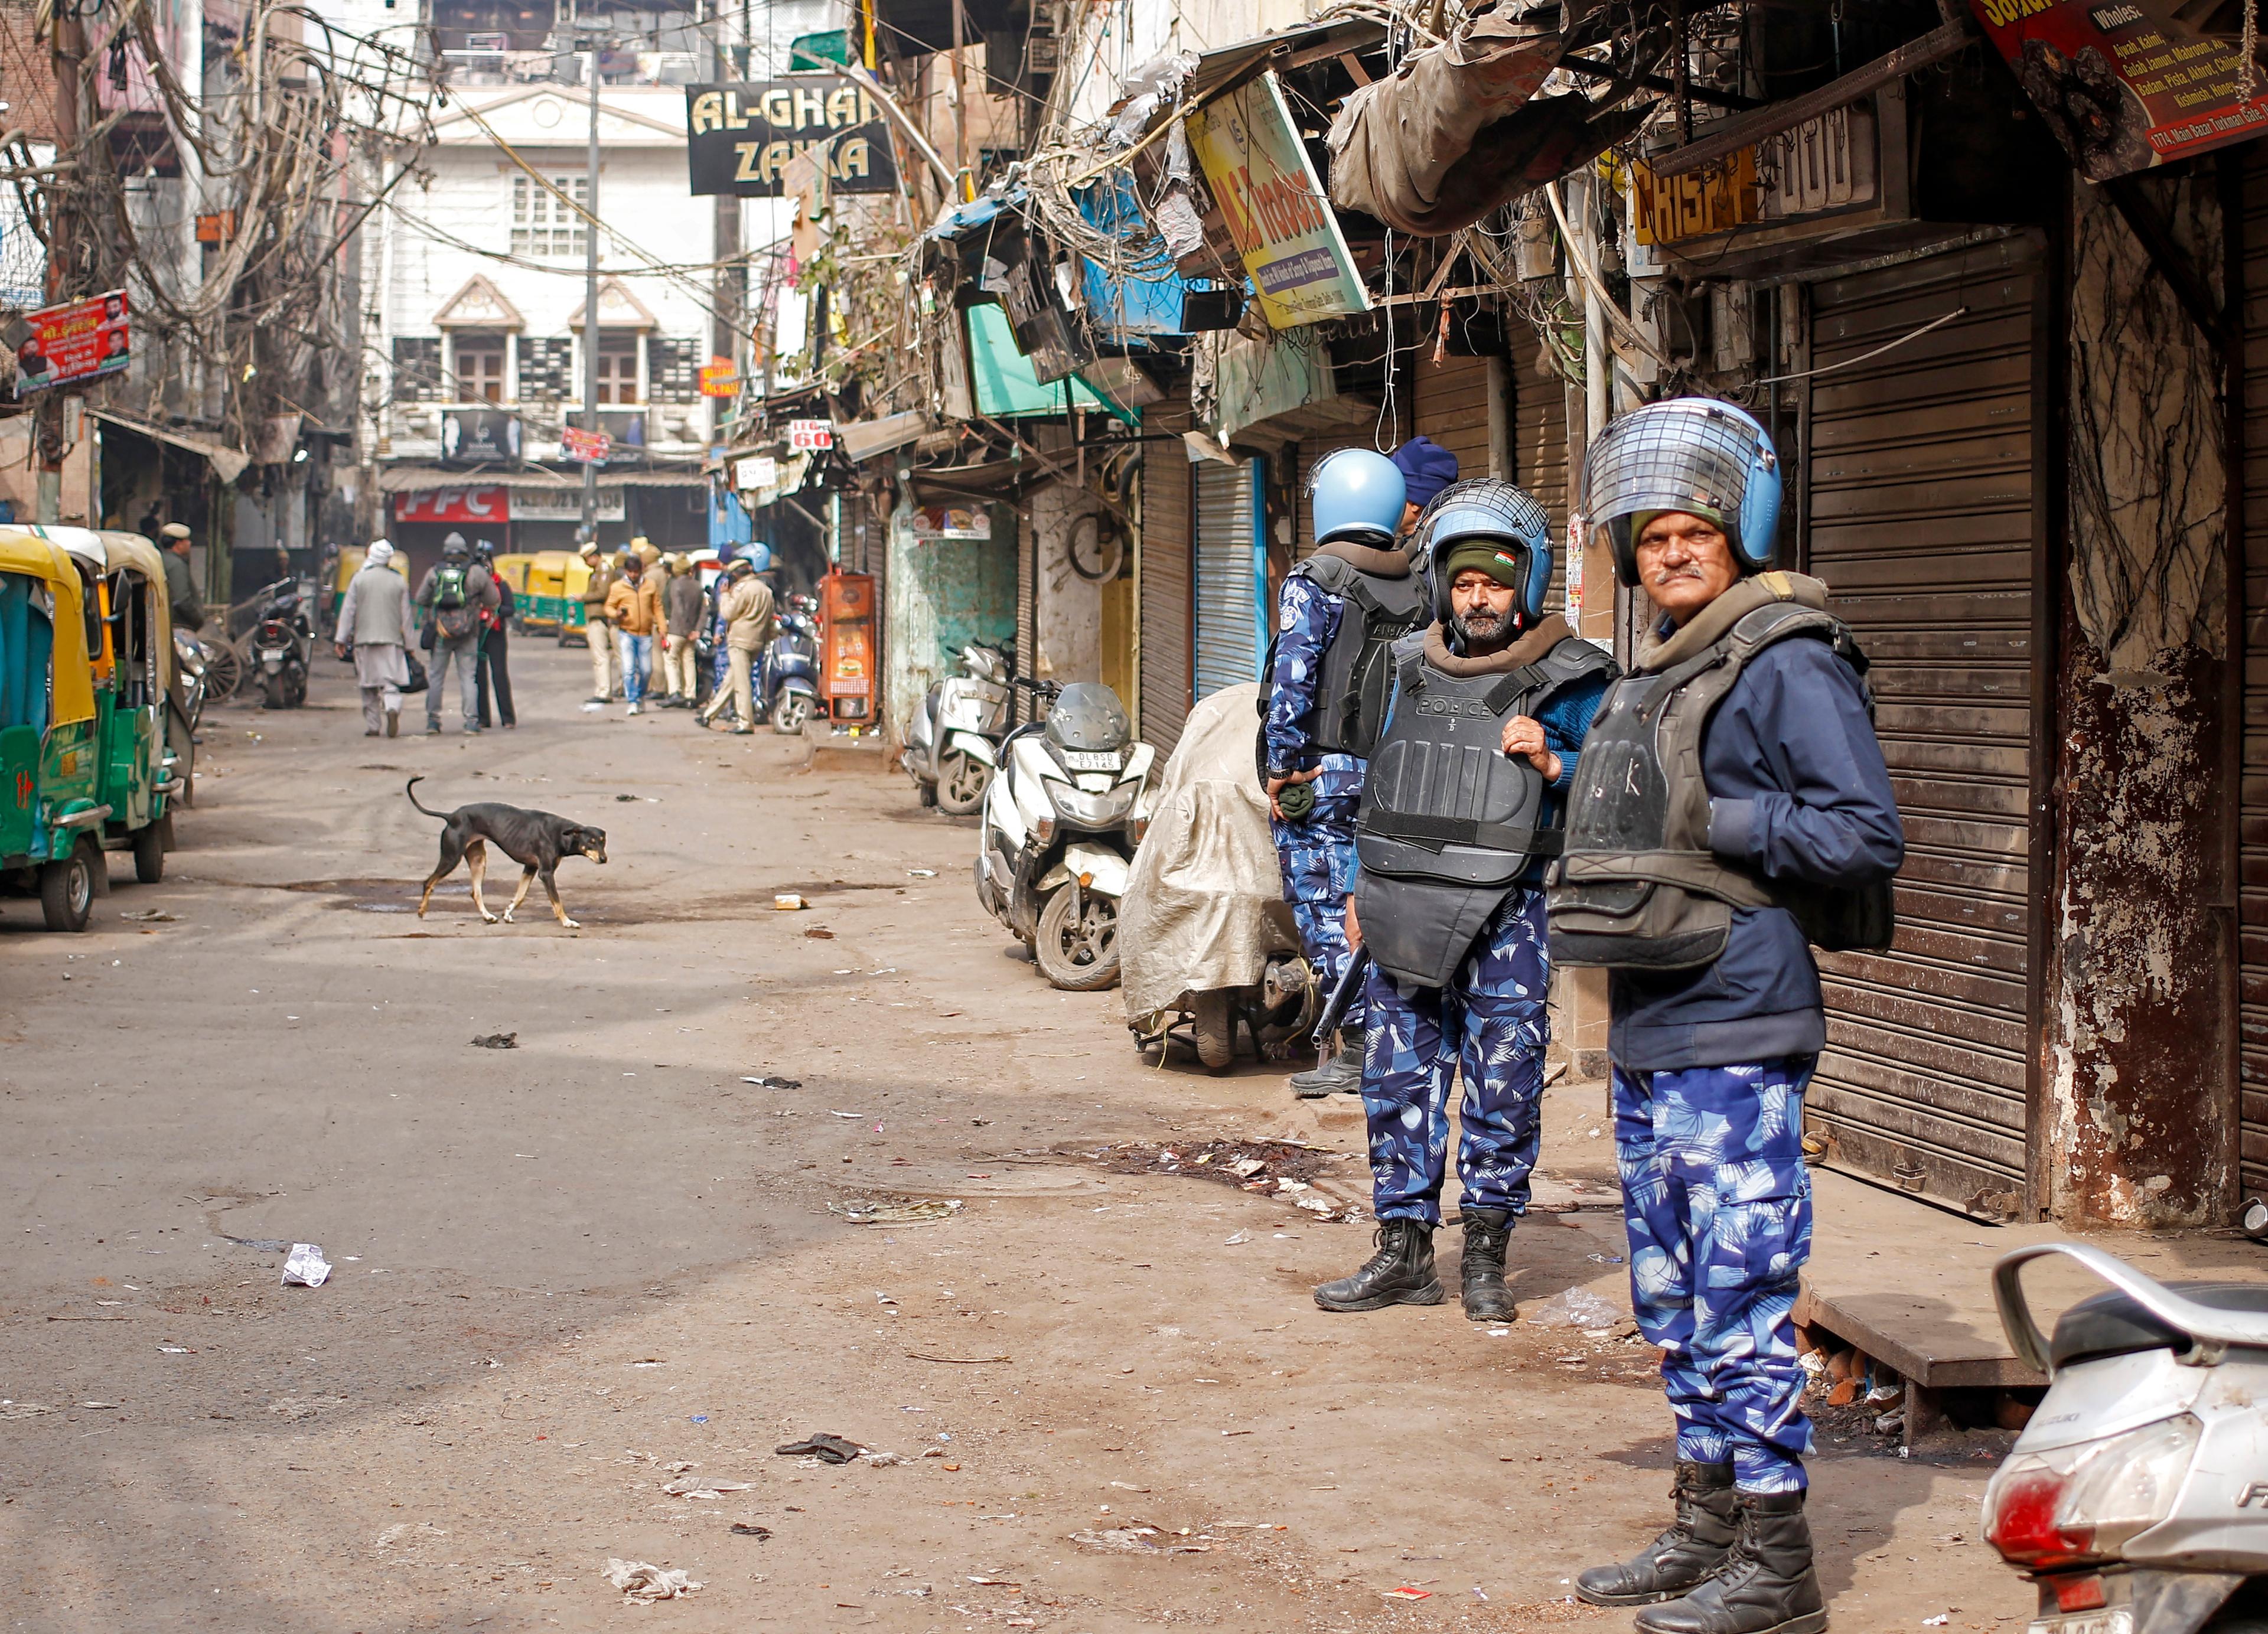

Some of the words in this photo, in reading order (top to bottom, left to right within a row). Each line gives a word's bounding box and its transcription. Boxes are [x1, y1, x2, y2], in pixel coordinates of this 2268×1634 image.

[2112, 40, 2143, 60] Ajwah,
[2136, 31, 2167, 50] Kalmi,
[2122, 60, 2149, 78] Gulab
[2146, 54, 2178, 71] Jamun,
[2171, 41, 2215, 62] Mabroom,
[2136, 79, 2169, 97] Badam,
[2163, 71, 2192, 87] Pista,
[2170, 126, 2193, 144] Main
[2188, 122, 2214, 138] Bazar
[2208, 113, 2245, 132] Turkman
[1237, 165, 1327, 245] Traders
[794, 432, 832, 447] 60
[405, 485, 500, 516] FFC
[1419, 699, 1491, 717] POLICE
